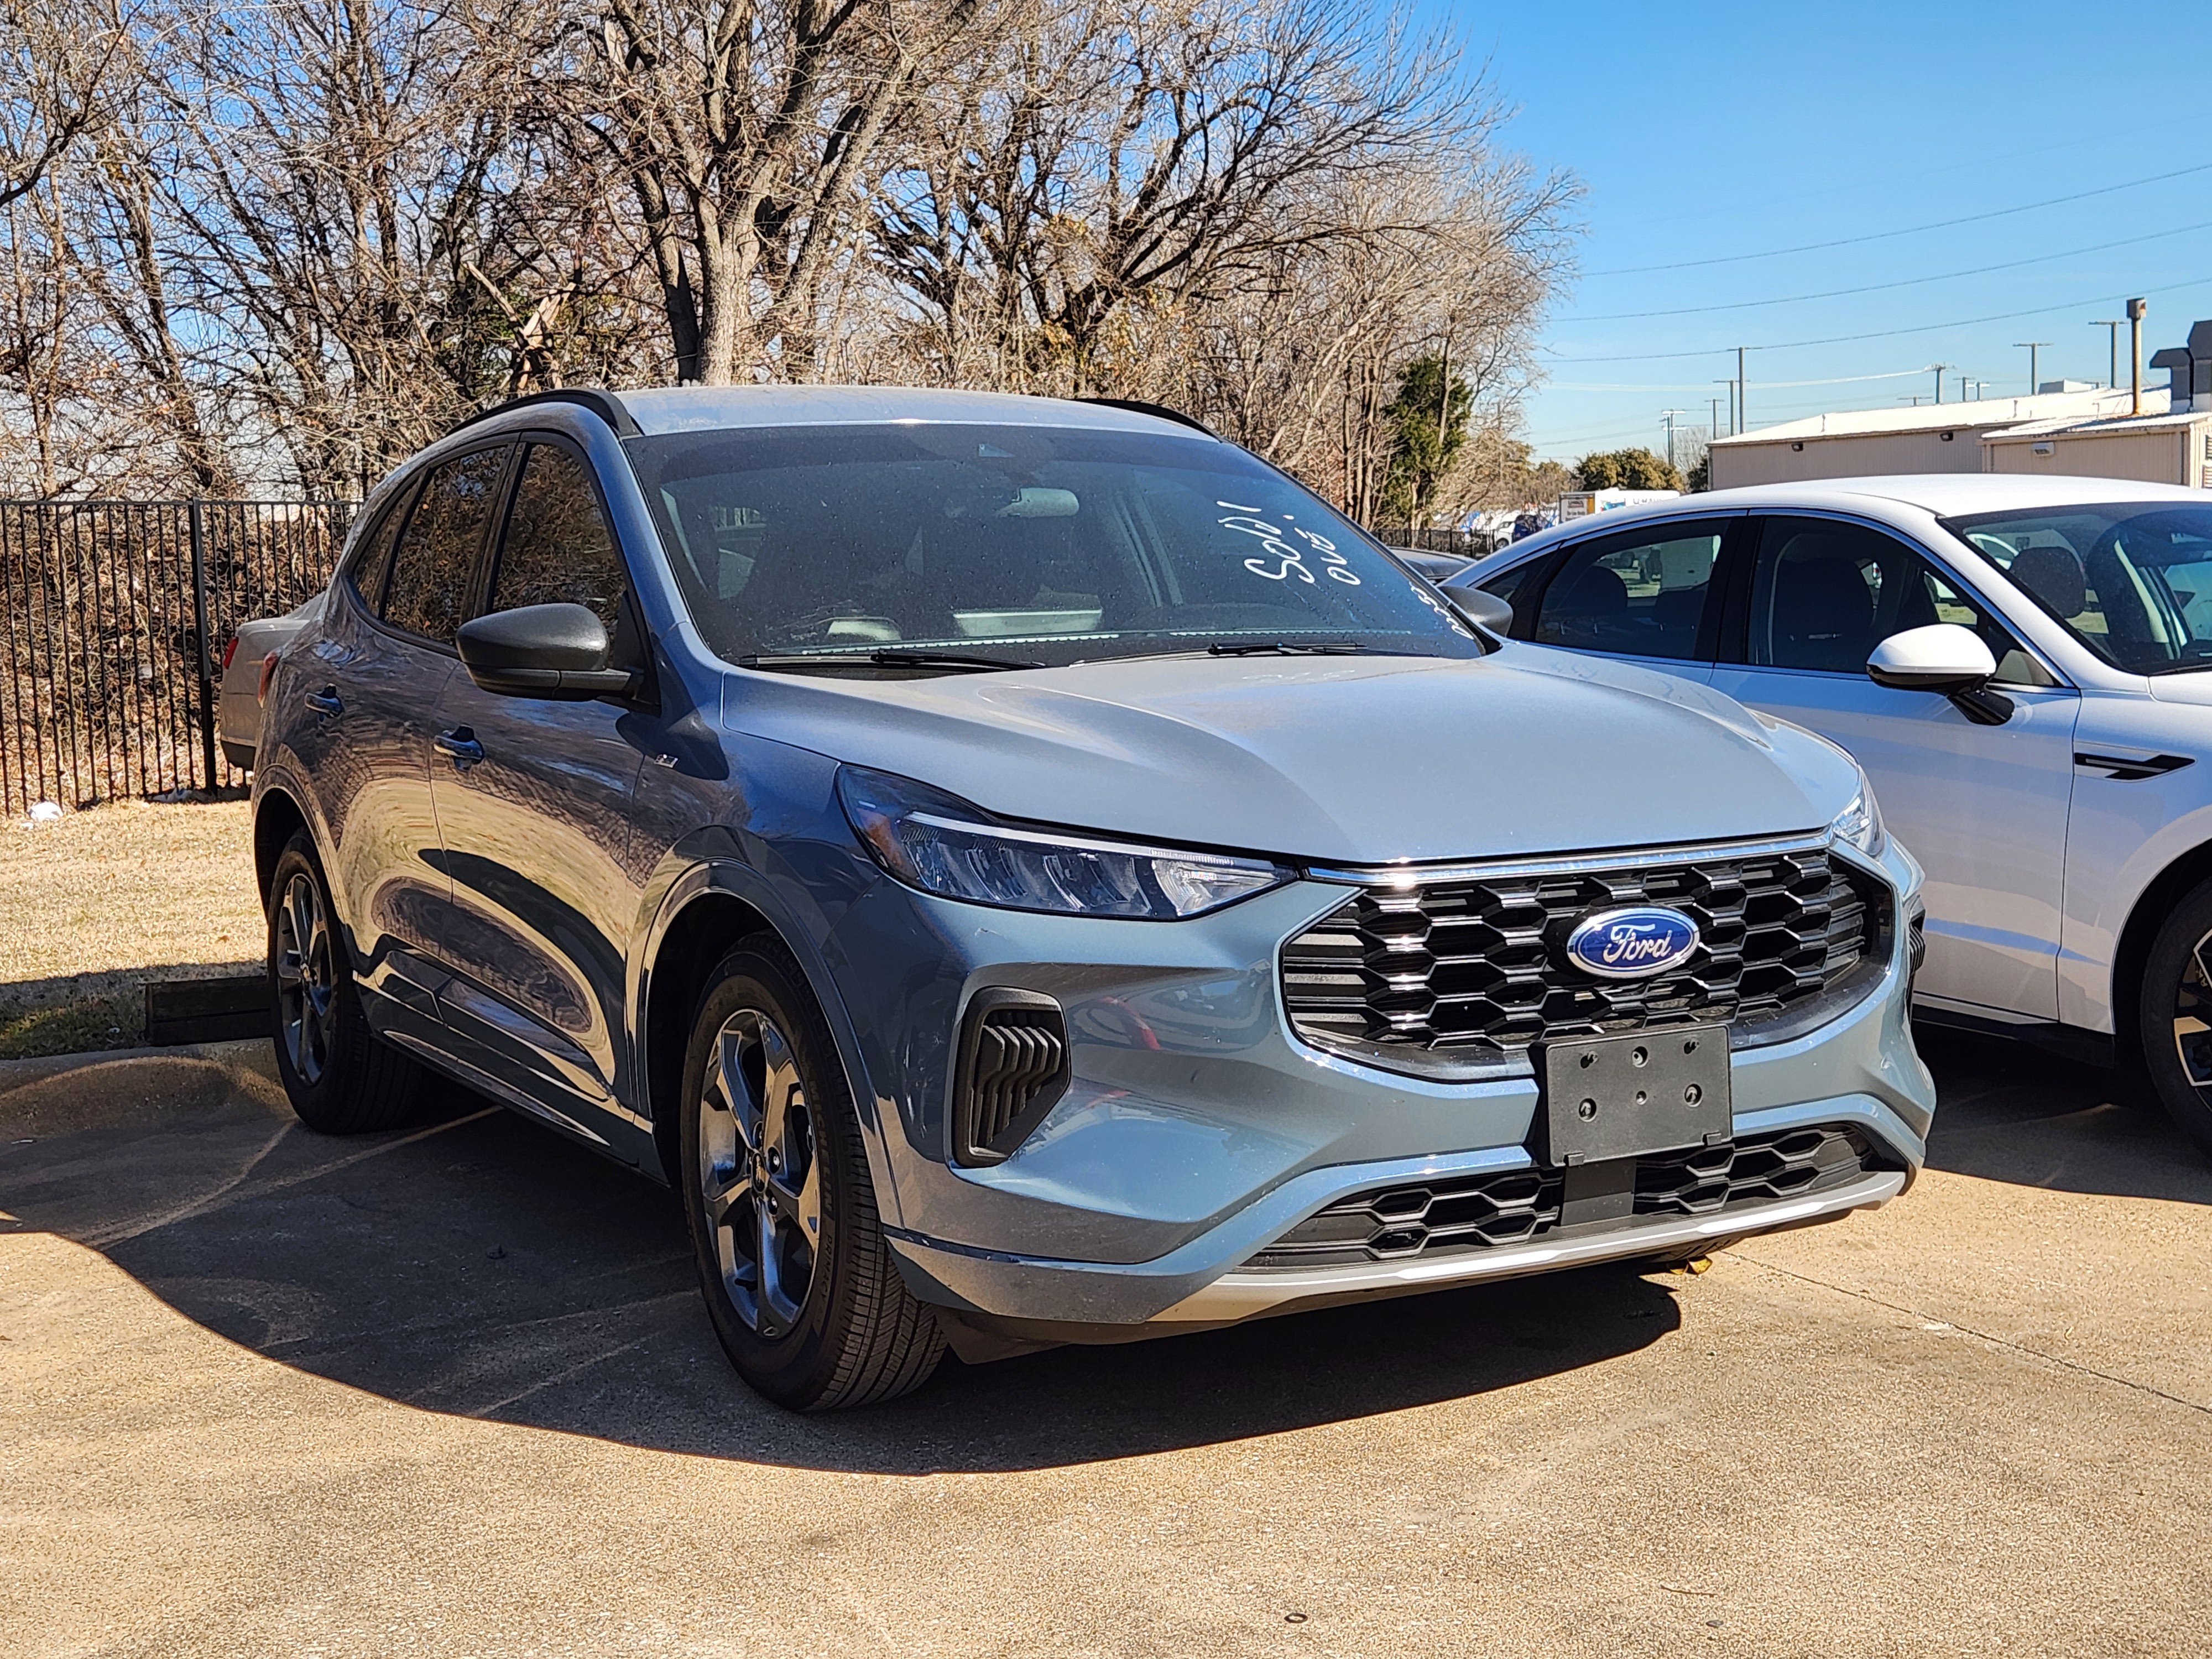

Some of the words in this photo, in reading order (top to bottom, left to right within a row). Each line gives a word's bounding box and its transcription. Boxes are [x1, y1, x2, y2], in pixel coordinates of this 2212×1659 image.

[1603, 923, 1673, 964] Ford
[808, 1079, 833, 1213] MICHELIN
[820, 1233, 833, 1298] PRIMACY
